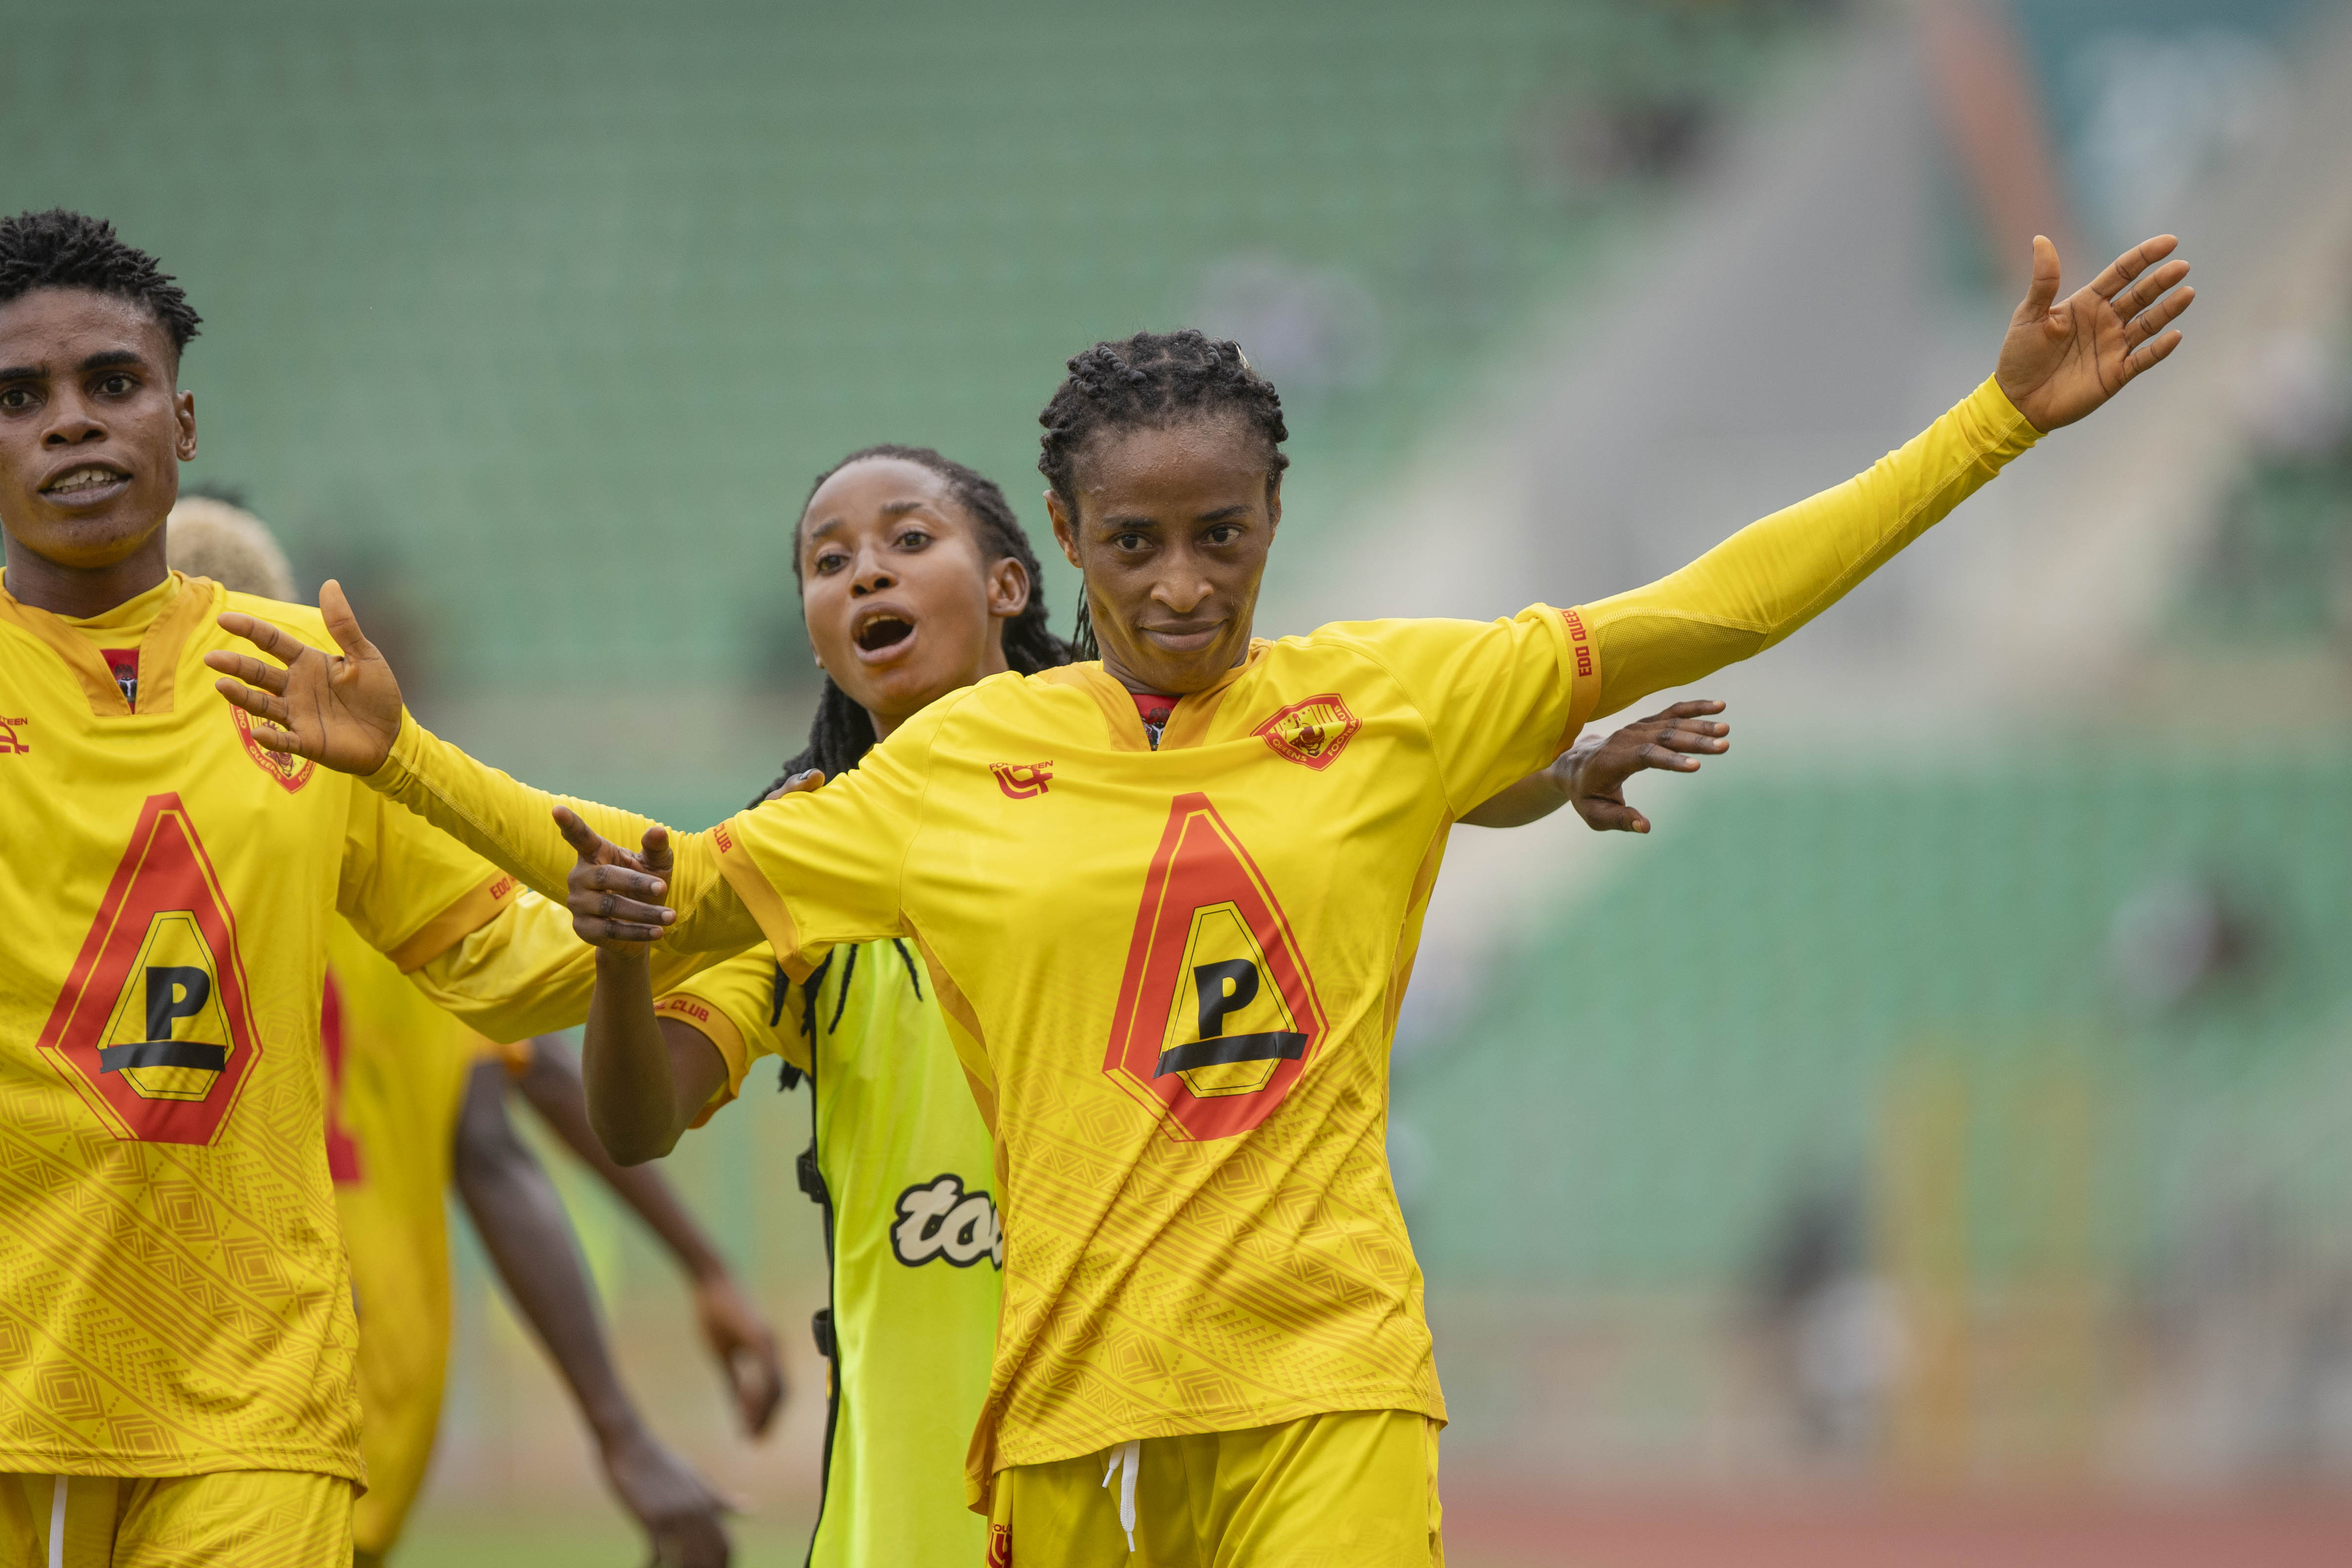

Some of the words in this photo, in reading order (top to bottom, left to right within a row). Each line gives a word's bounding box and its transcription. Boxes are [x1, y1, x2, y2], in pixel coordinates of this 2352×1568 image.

[1576, 646, 1592, 677] EDO
[146, 966, 210, 1041] P
[670, 999, 710, 1022] CLUB
[1193, 958, 1259, 1040] P
